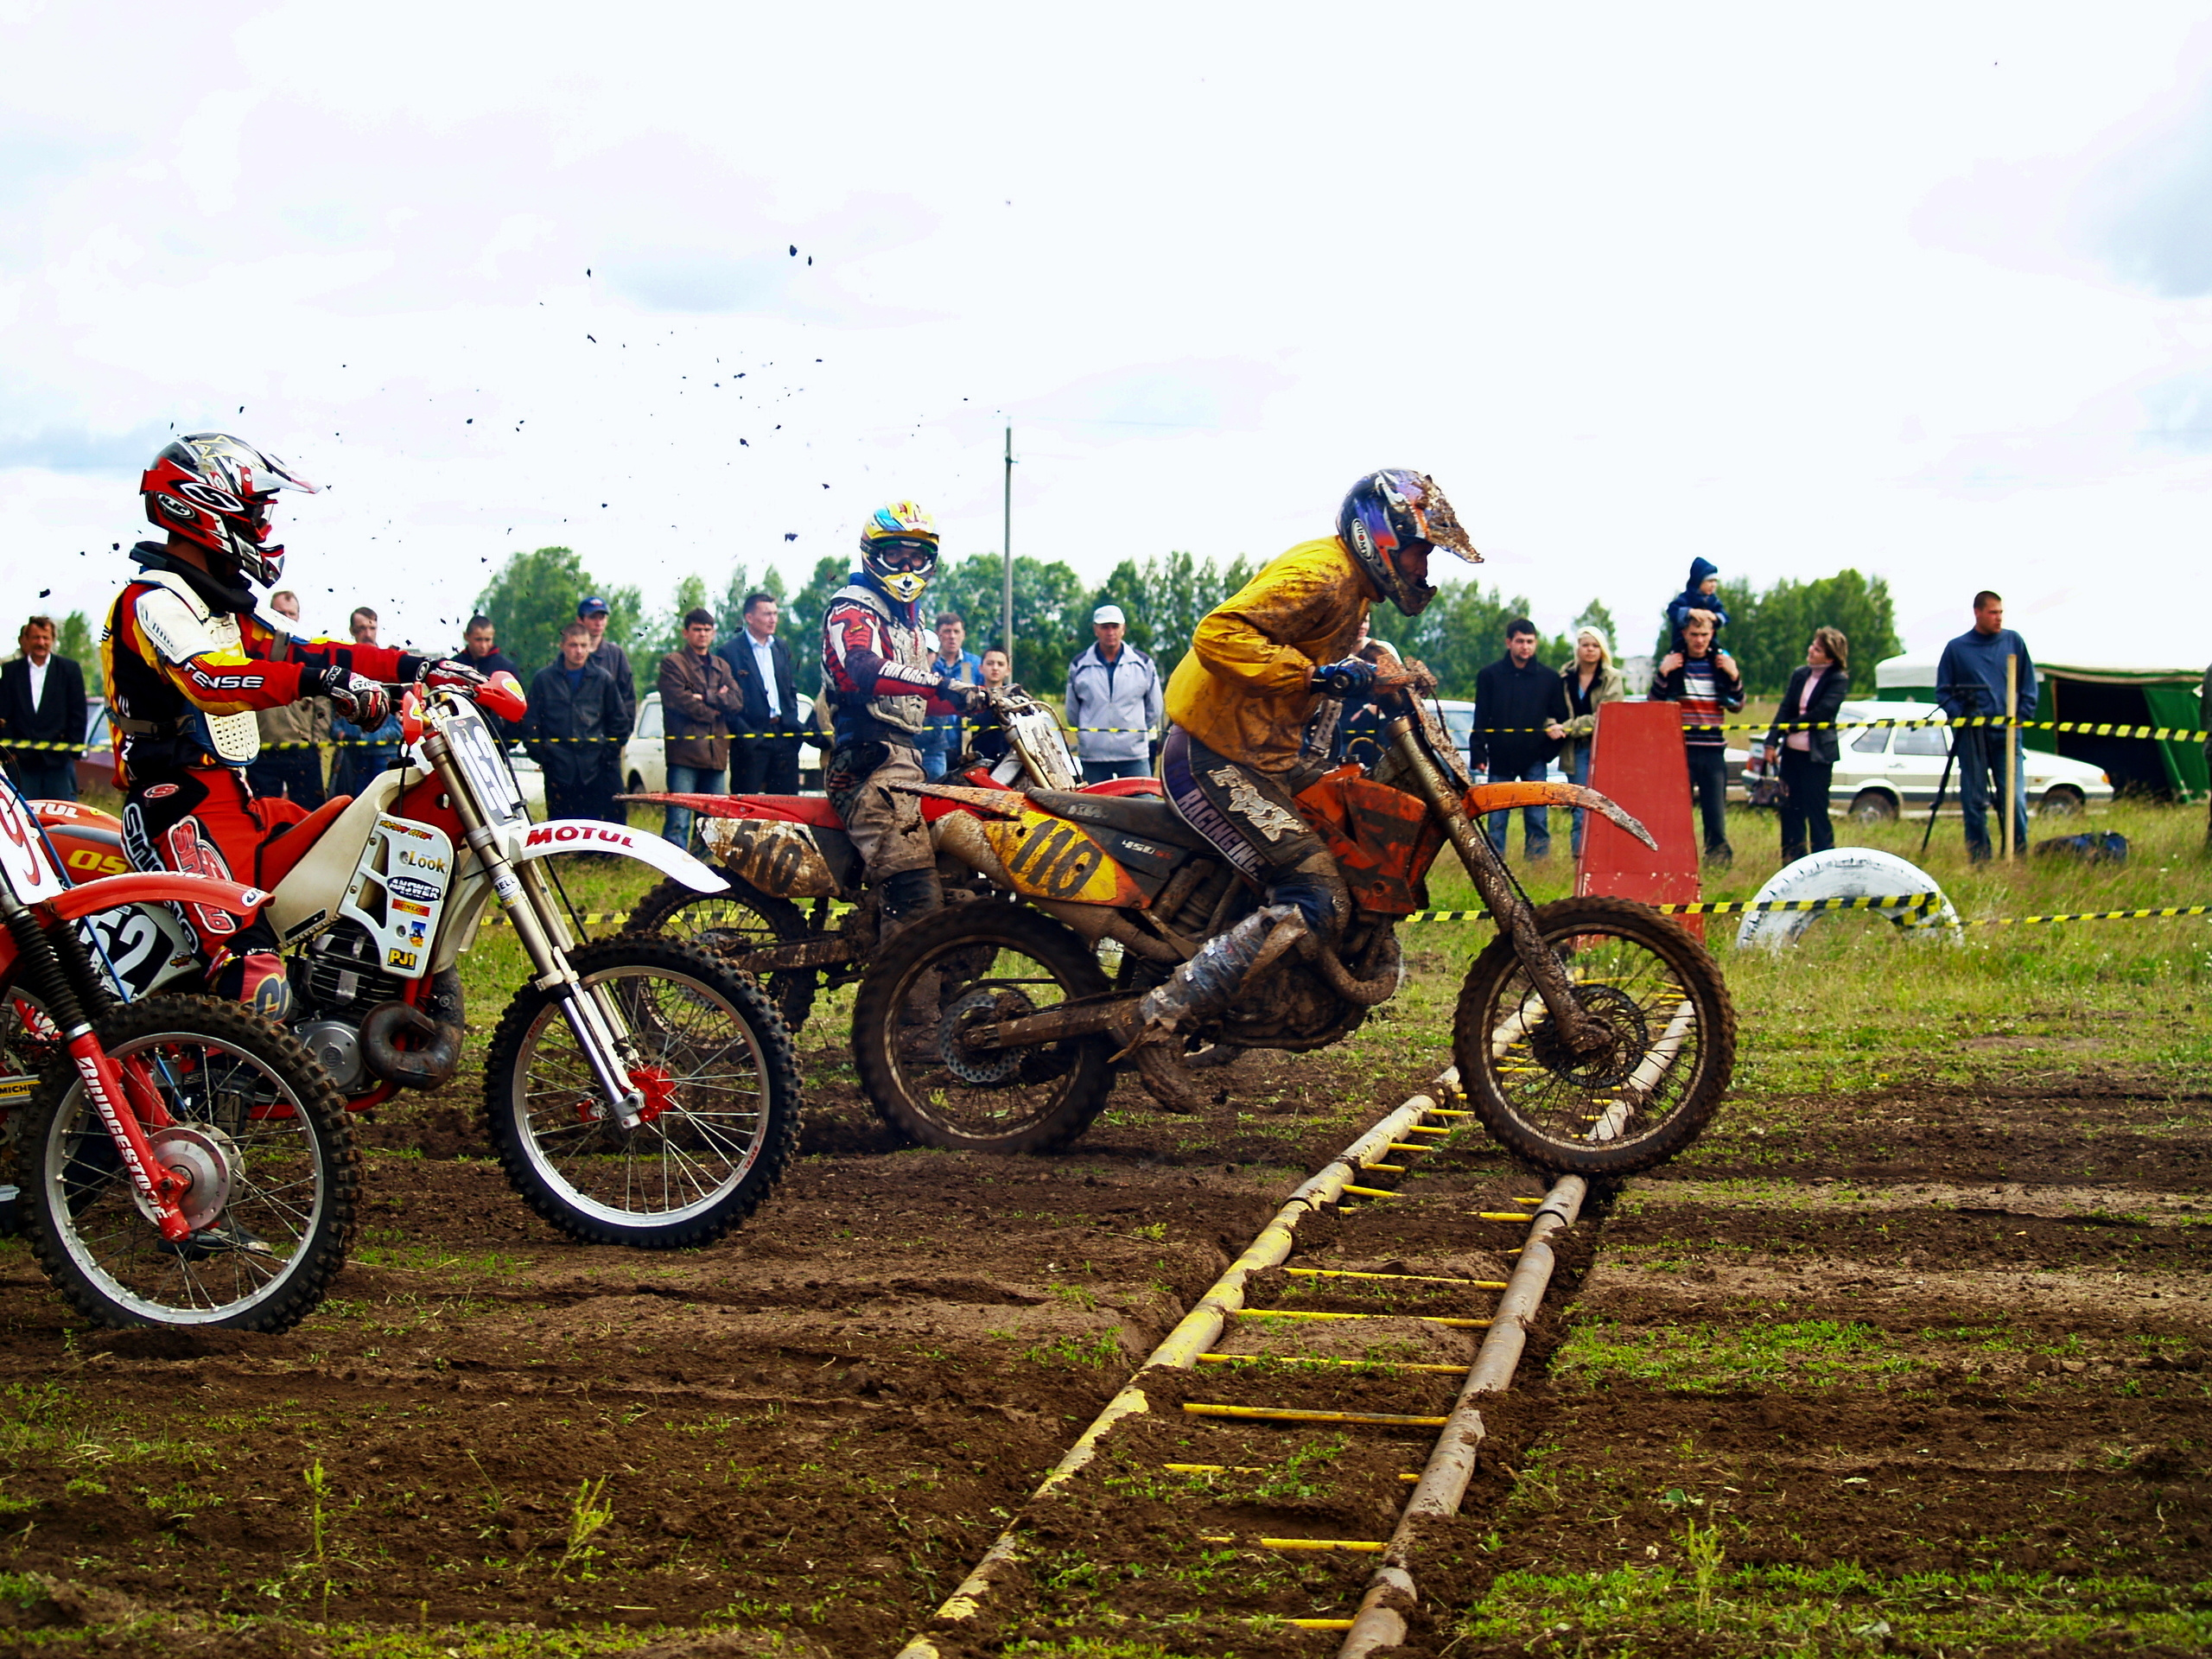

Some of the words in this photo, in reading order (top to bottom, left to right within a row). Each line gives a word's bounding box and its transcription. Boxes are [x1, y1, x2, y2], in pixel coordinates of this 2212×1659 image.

[160, 496, 188, 514] HJC
[524, 826, 633, 848] MOTUL
[409, 851, 445, 874] Look
[389, 878, 440, 899] ANSWER
[389, 950, 417, 968] PJ1
